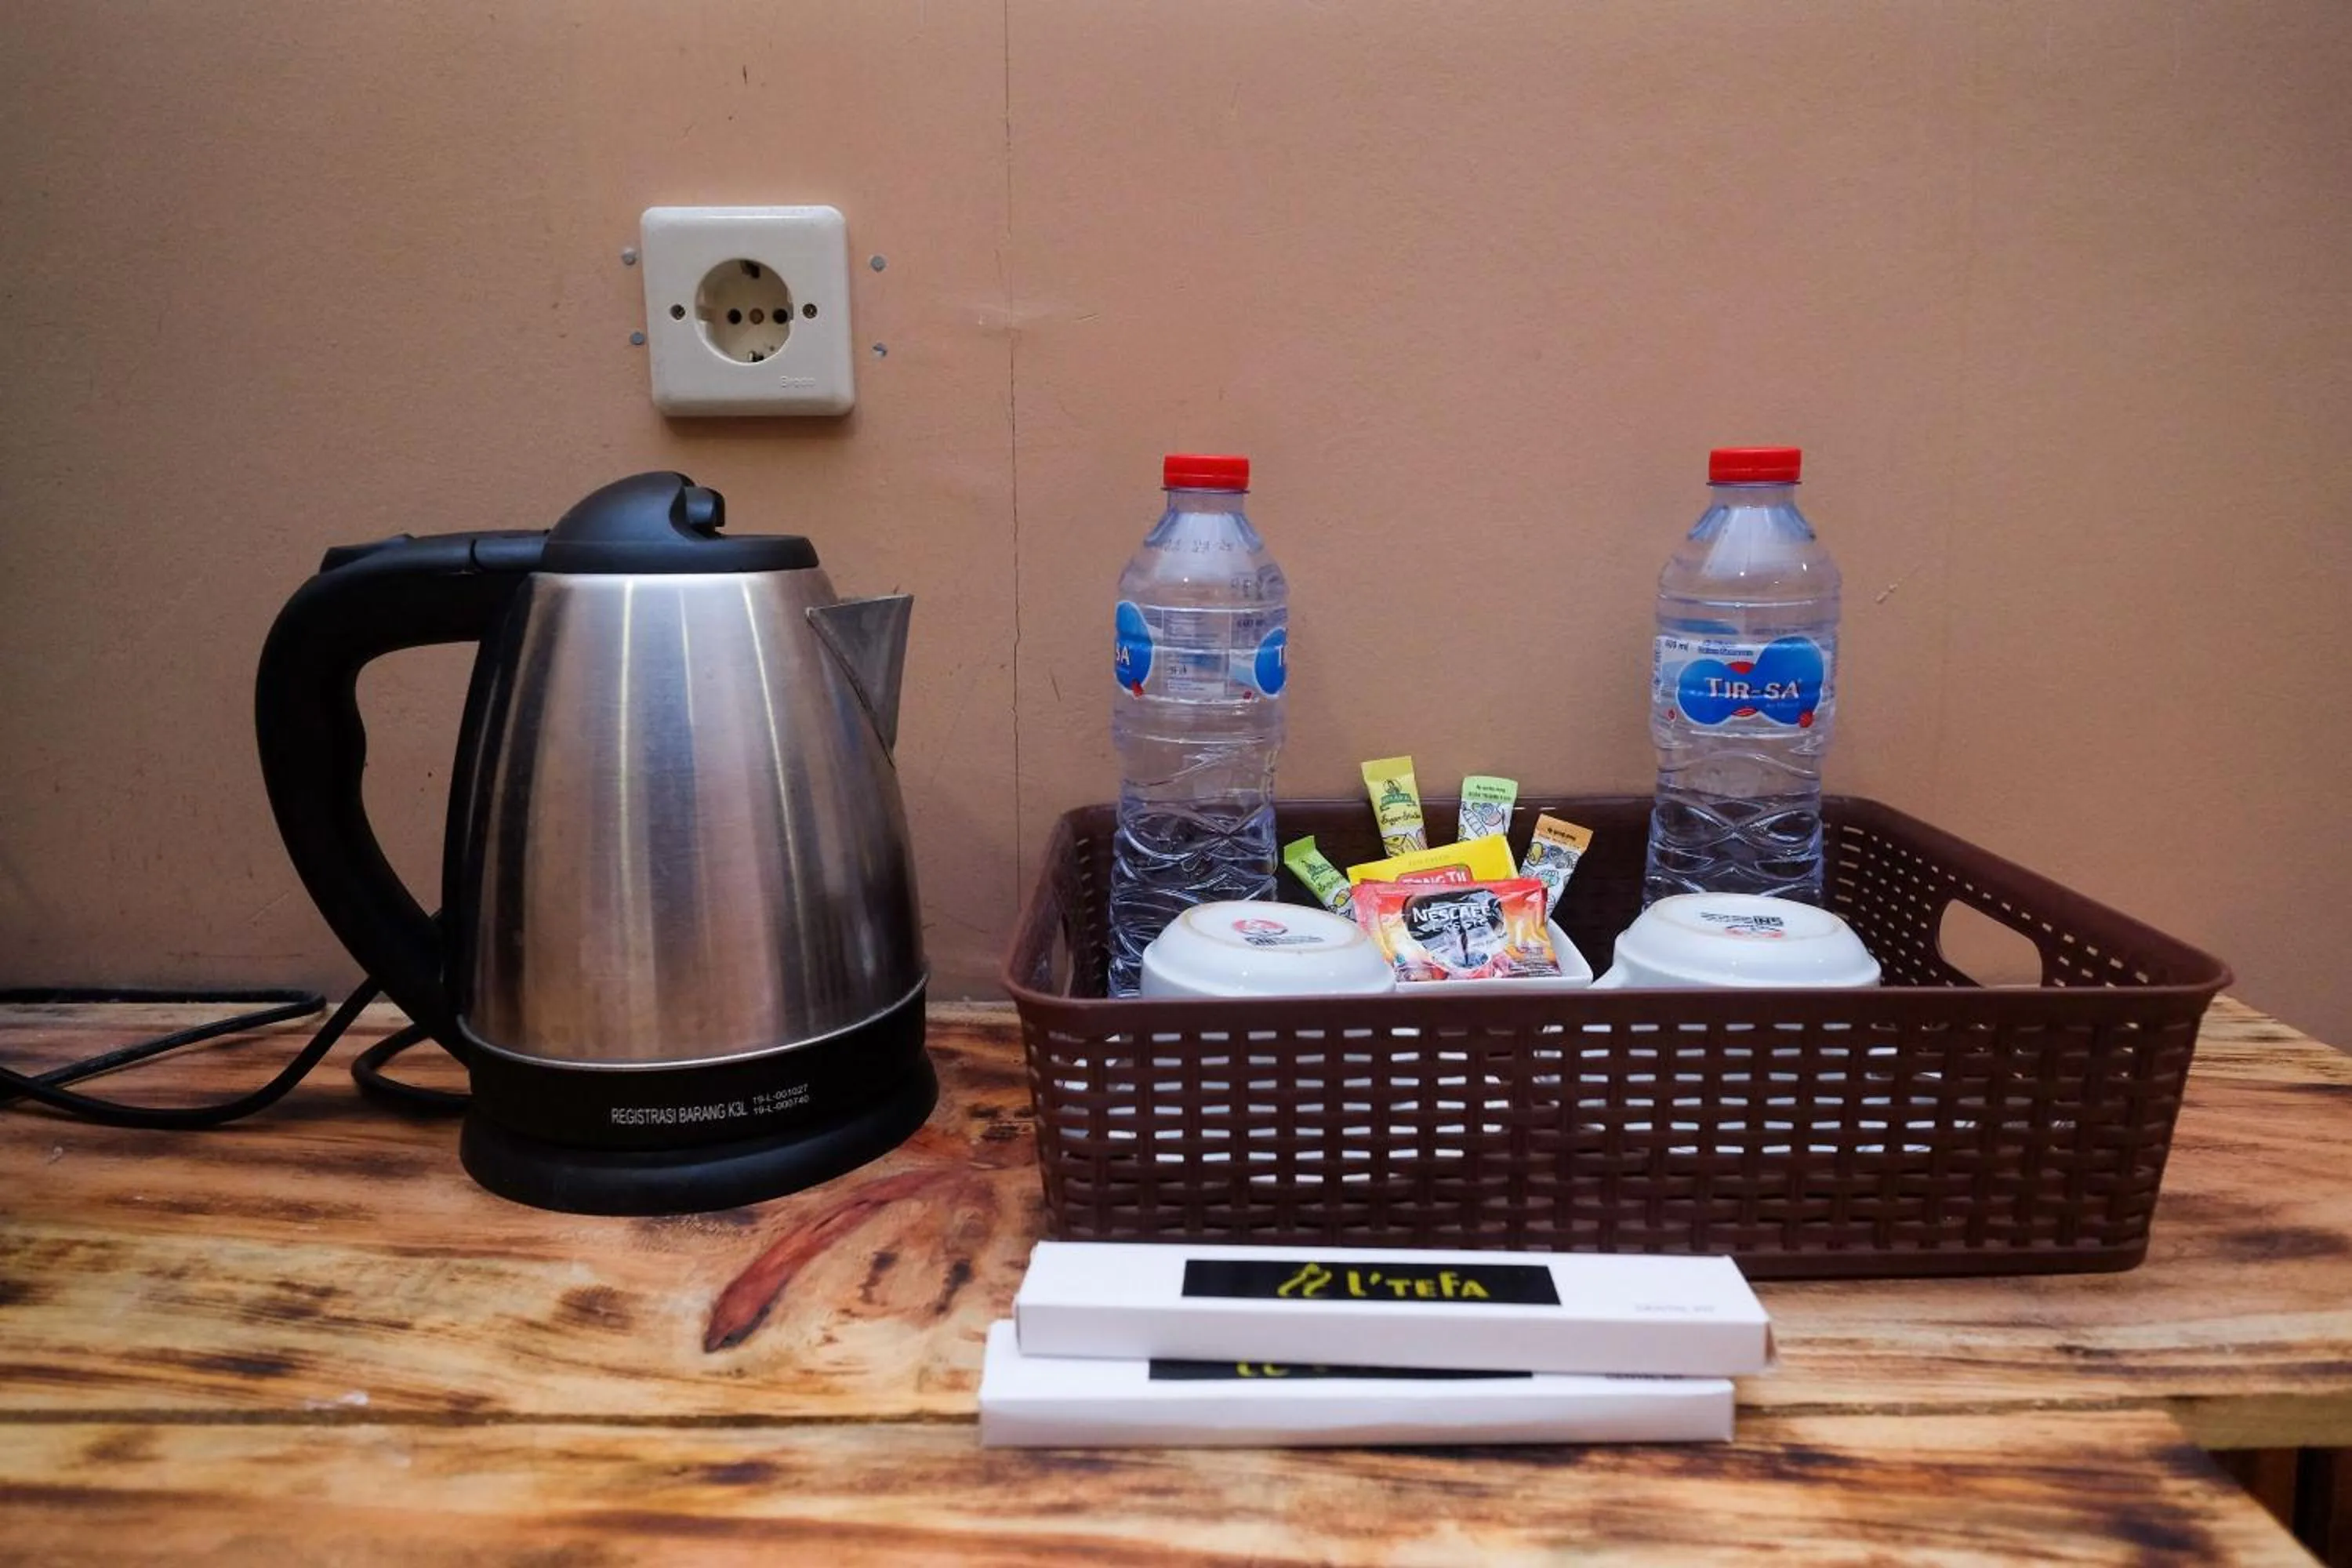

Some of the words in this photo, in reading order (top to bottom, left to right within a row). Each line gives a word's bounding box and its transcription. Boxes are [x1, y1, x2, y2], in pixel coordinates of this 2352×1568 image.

[1704, 677, 1801, 700] TIR-SA
[611, 1106, 677, 1125] REGISTRASI
[678, 1103, 727, 1124] BARANG
[728, 1100, 749, 1117] K3L
